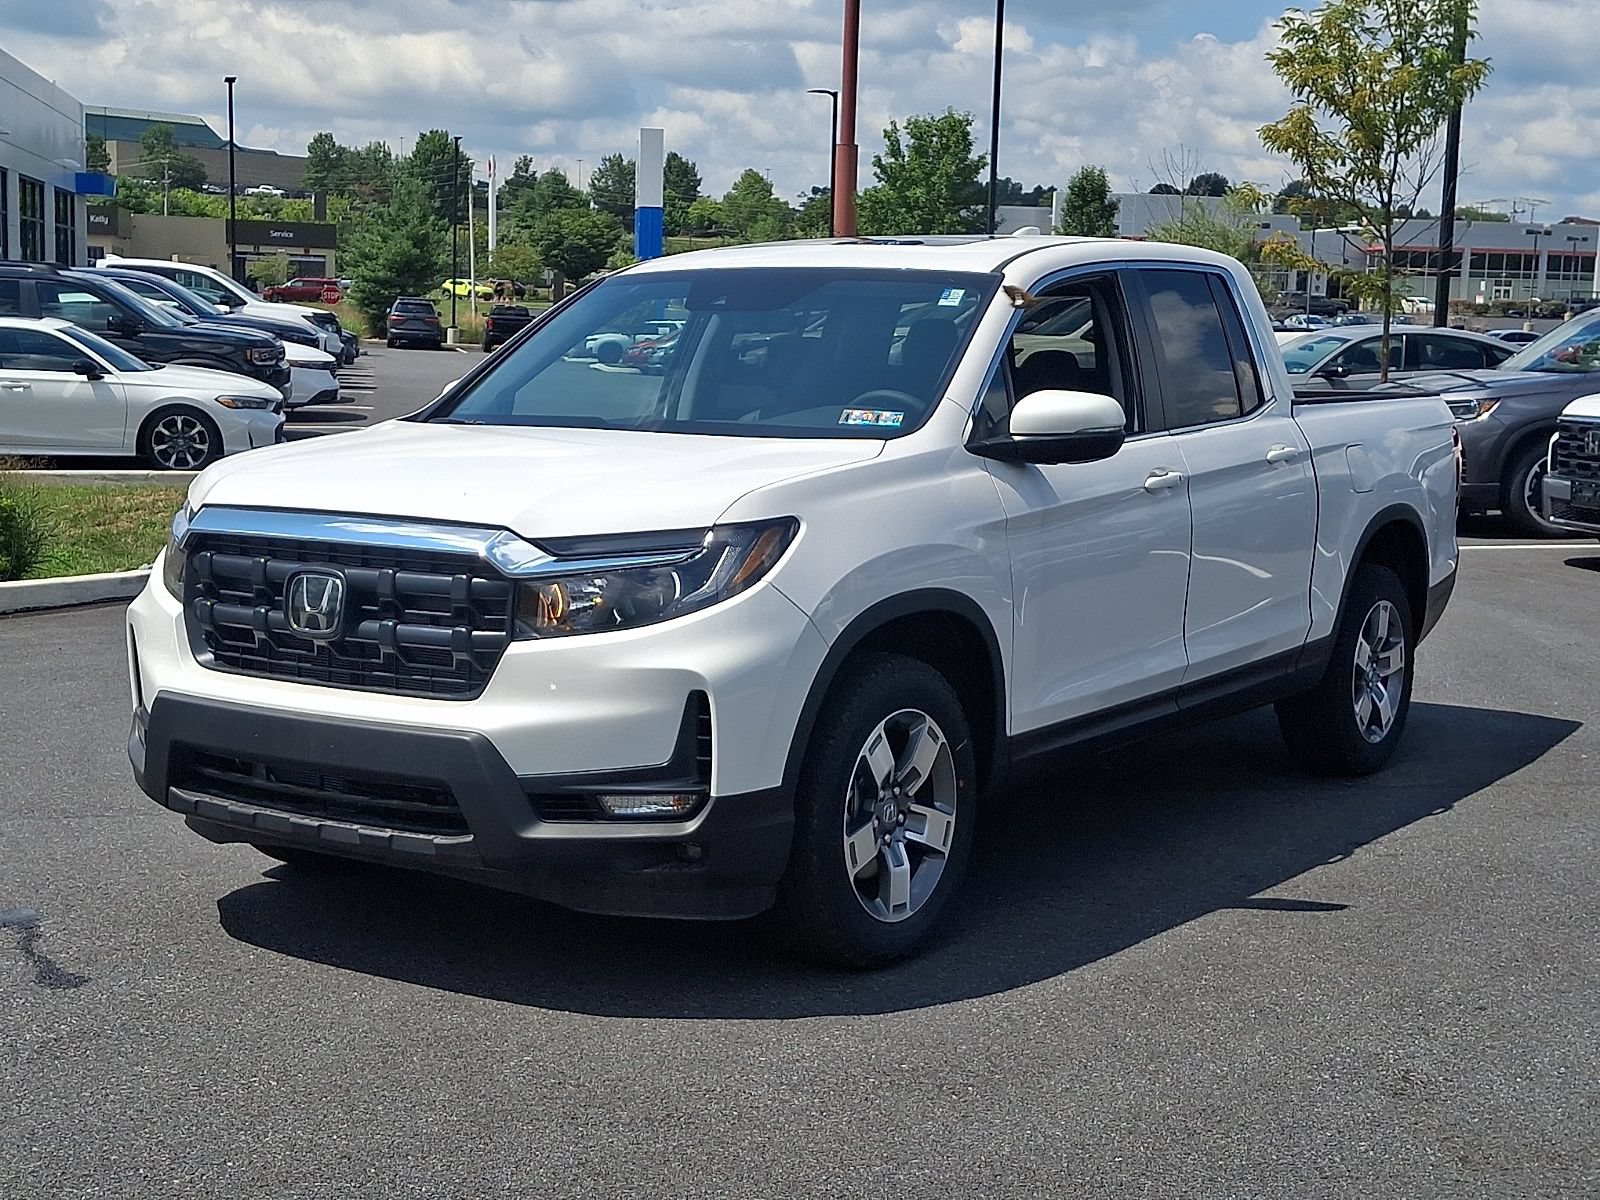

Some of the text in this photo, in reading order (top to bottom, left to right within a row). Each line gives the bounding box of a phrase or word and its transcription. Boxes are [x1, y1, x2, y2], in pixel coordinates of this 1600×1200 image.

[90, 214, 109, 225] Kelly
[269, 229, 294, 238] Service
[323, 291, 340, 299] STOP
